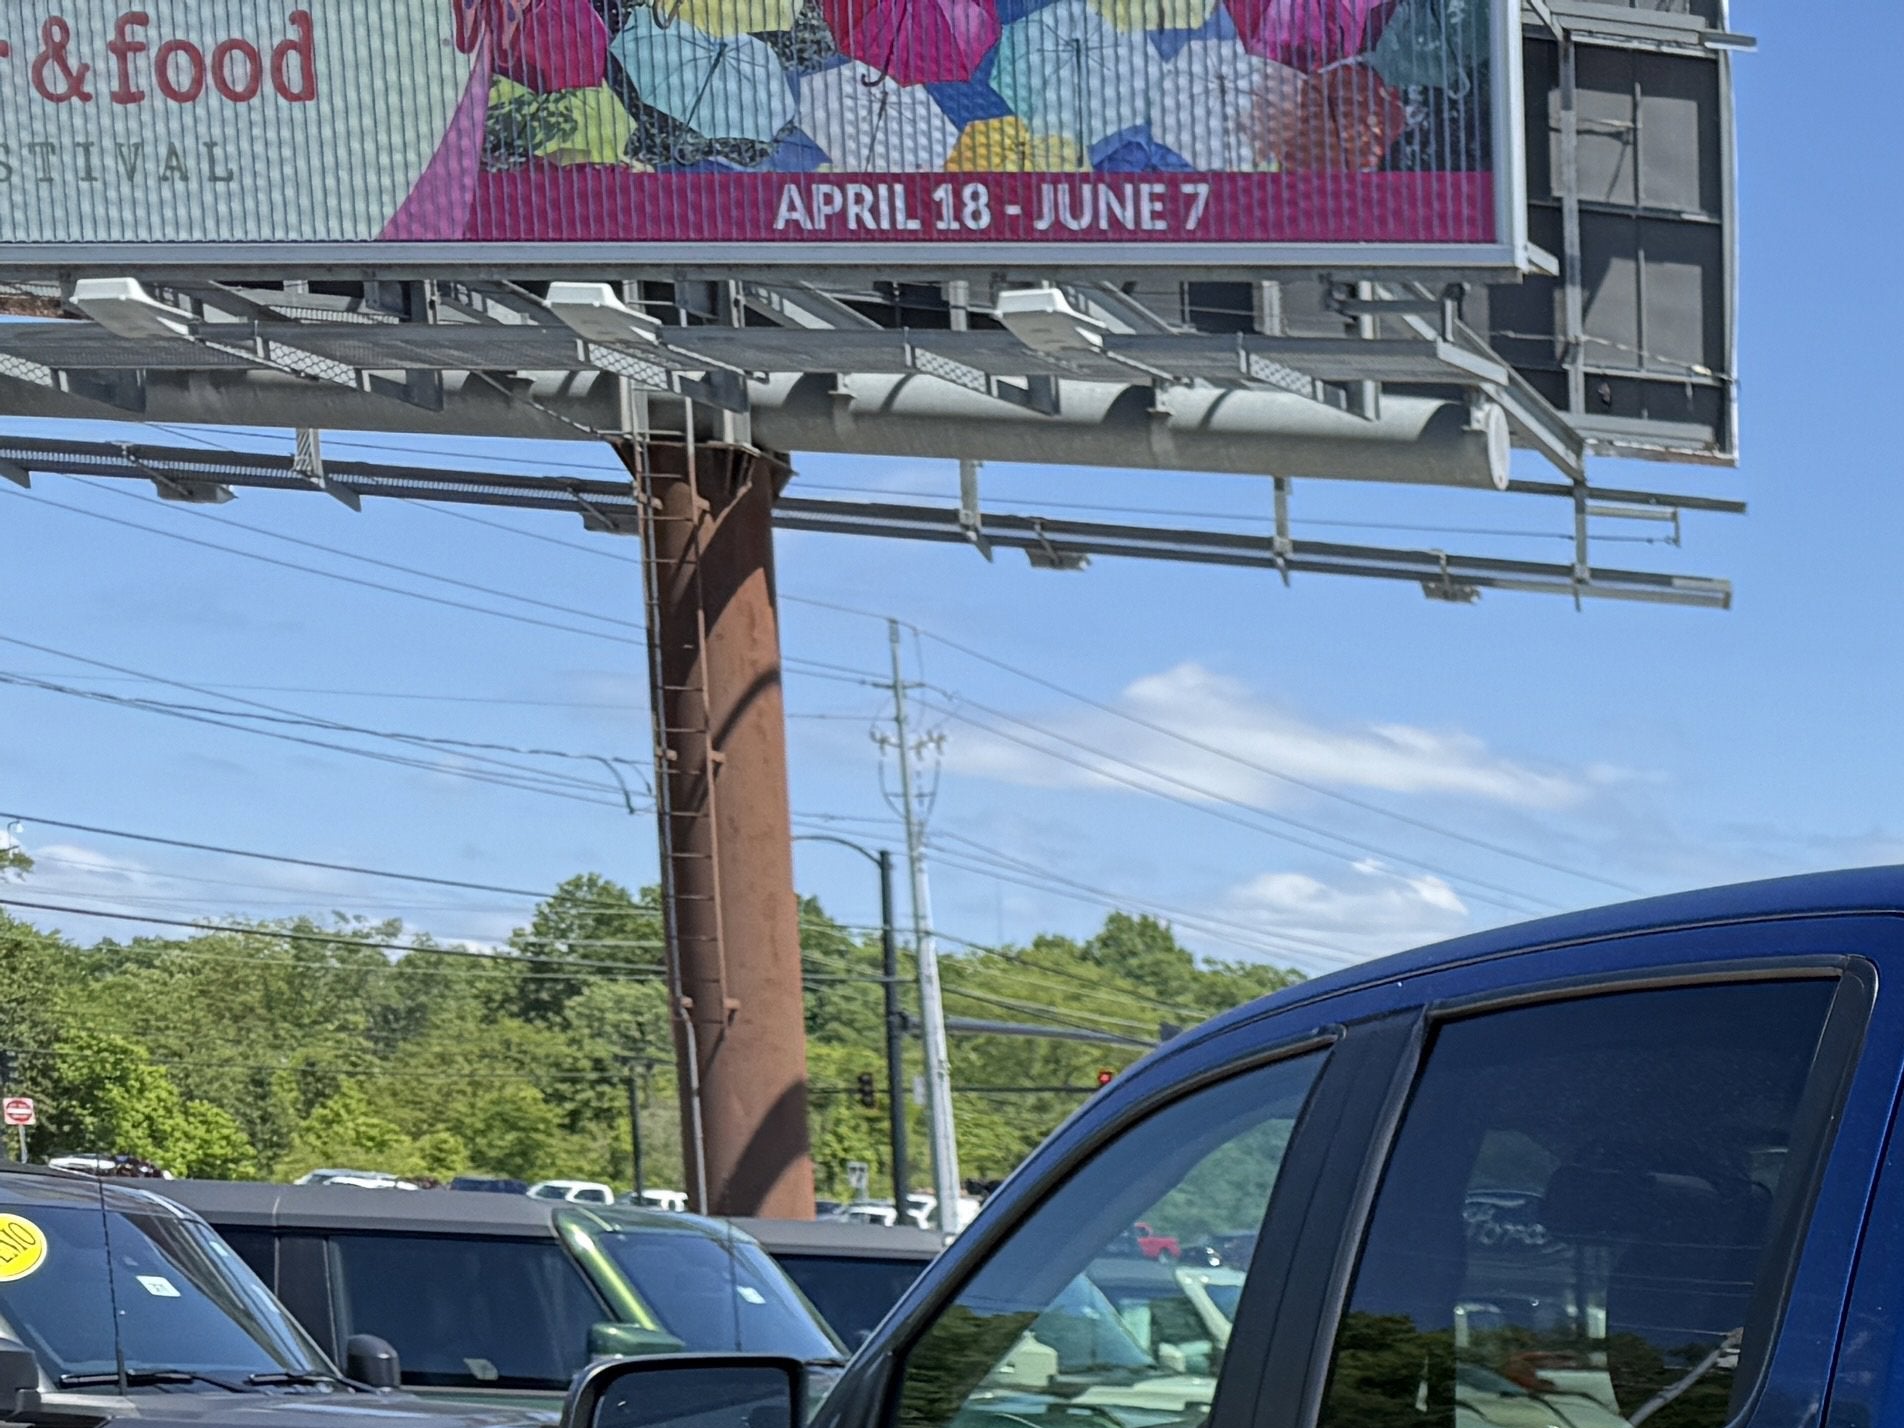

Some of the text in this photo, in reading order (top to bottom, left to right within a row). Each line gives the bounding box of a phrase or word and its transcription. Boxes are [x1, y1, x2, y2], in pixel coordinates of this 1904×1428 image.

[31, 10, 315, 104] & food
[773, 182, 1210, 231] APRIL 18 - JUNE 7
